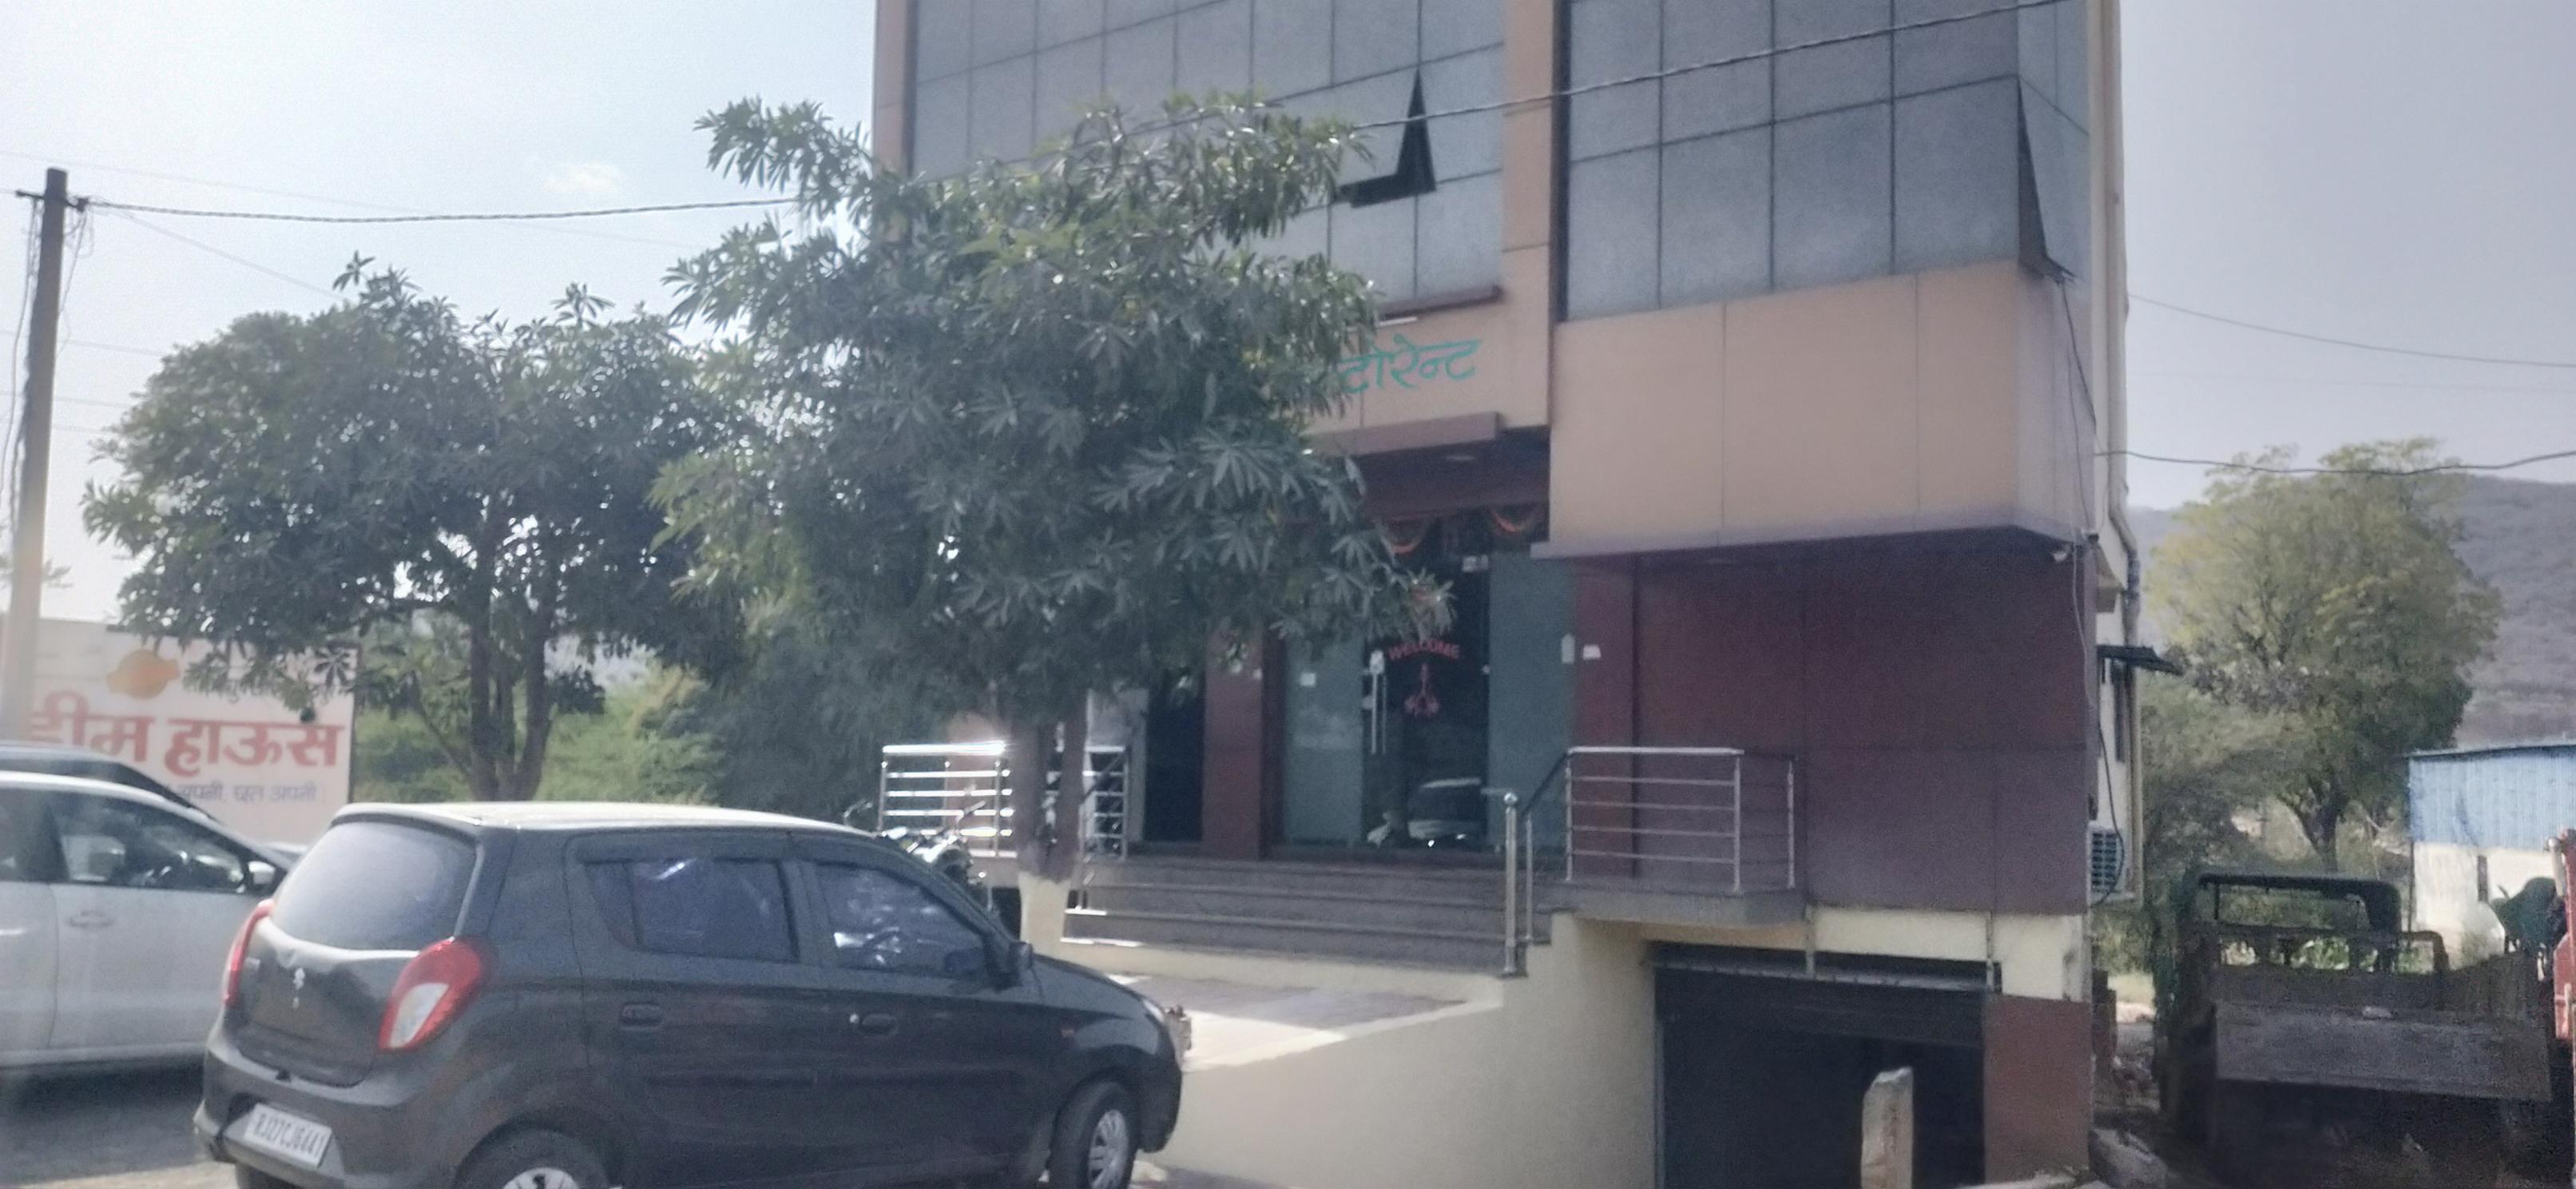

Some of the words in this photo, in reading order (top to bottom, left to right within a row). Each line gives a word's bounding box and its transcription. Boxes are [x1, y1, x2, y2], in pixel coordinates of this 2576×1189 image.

[1338, 332, 1482, 394] टोरेन्ट
[1388, 638, 1461, 660] WELCOME
[164, 718, 345, 777] हाऊस
